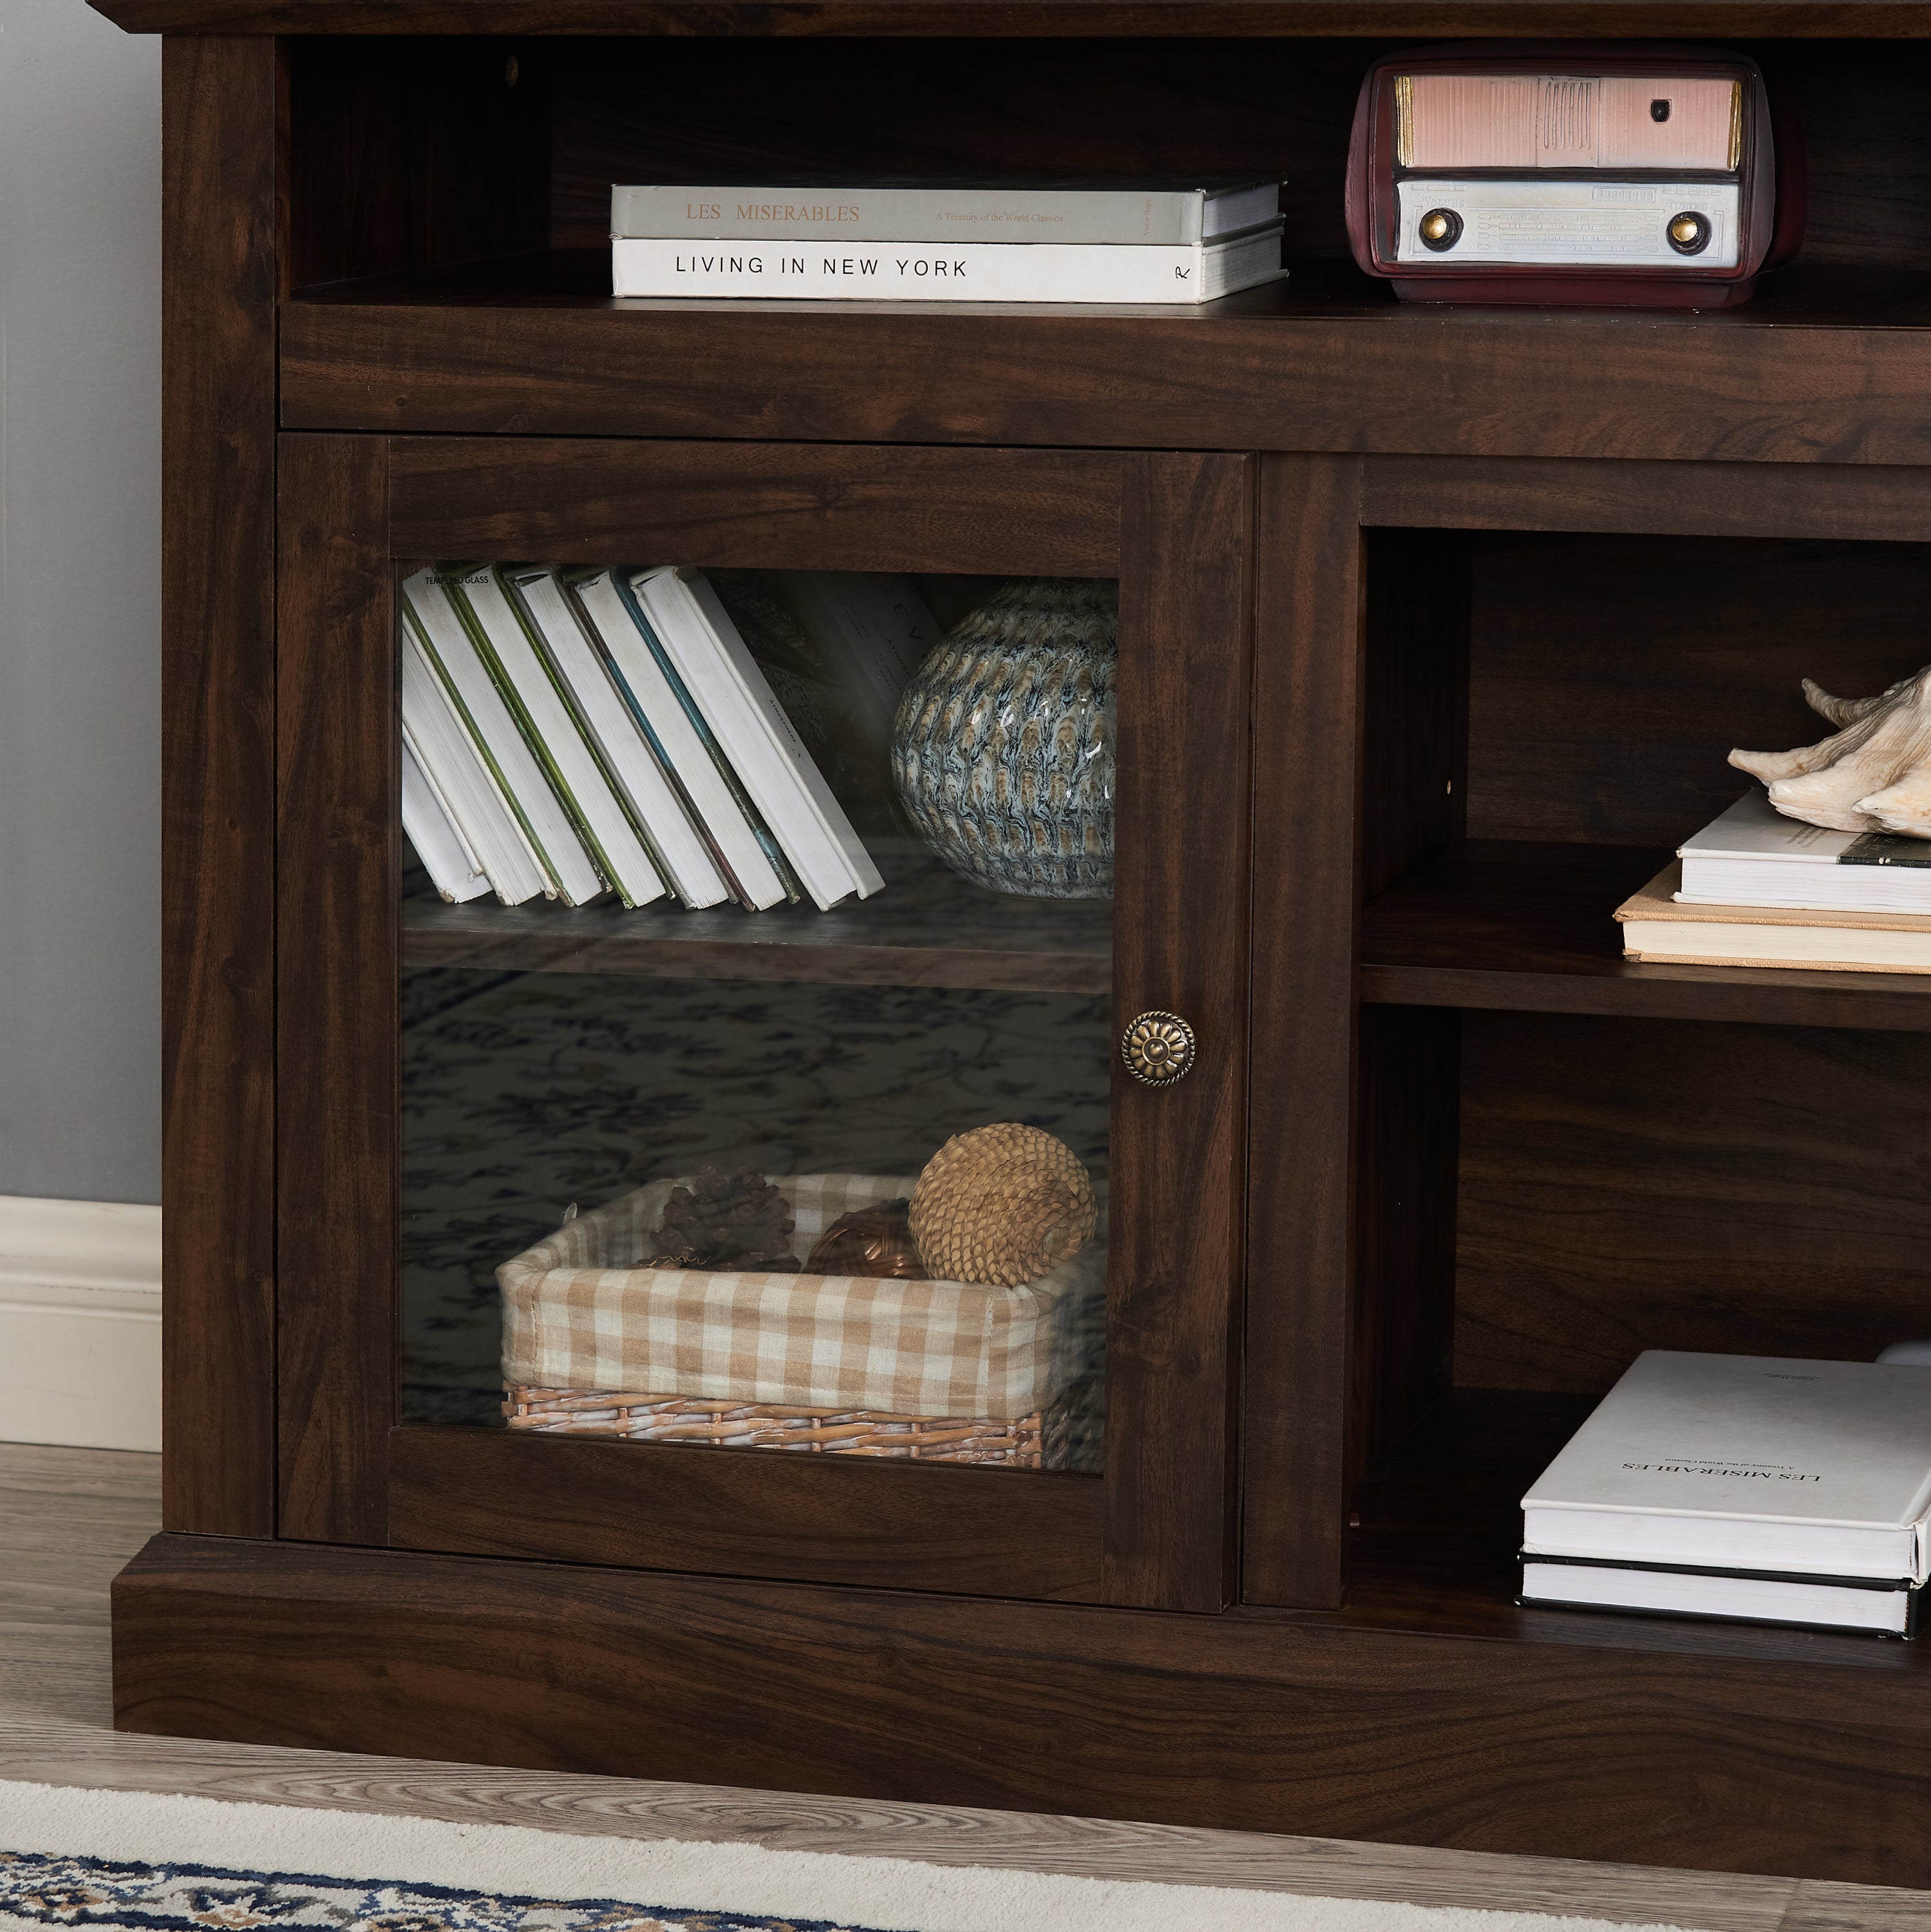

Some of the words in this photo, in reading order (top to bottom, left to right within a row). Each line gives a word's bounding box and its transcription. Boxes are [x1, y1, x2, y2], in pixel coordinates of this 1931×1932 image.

[685, 204, 721, 220] LES
[736, 204, 860, 222] MISERABLES
[936, 213, 943, 221] A
[945, 213, 978, 223] Treasury
[981, 213, 990, 222] of
[991, 213, 1003, 222] the
[1004, 213, 1030, 222] World
[676, 256, 763, 274] LIVING
[781, 258, 805, 274] IN
[824, 259, 879, 276] NEW
[896, 260, 967, 277] YORK
[425, 576, 464, 585] TEMPERED
[464, 576, 489, 584] GLASS
[1622, 1463, 1773, 1479] MISERABLES
[1778, 1473, 1823, 1482] LES
